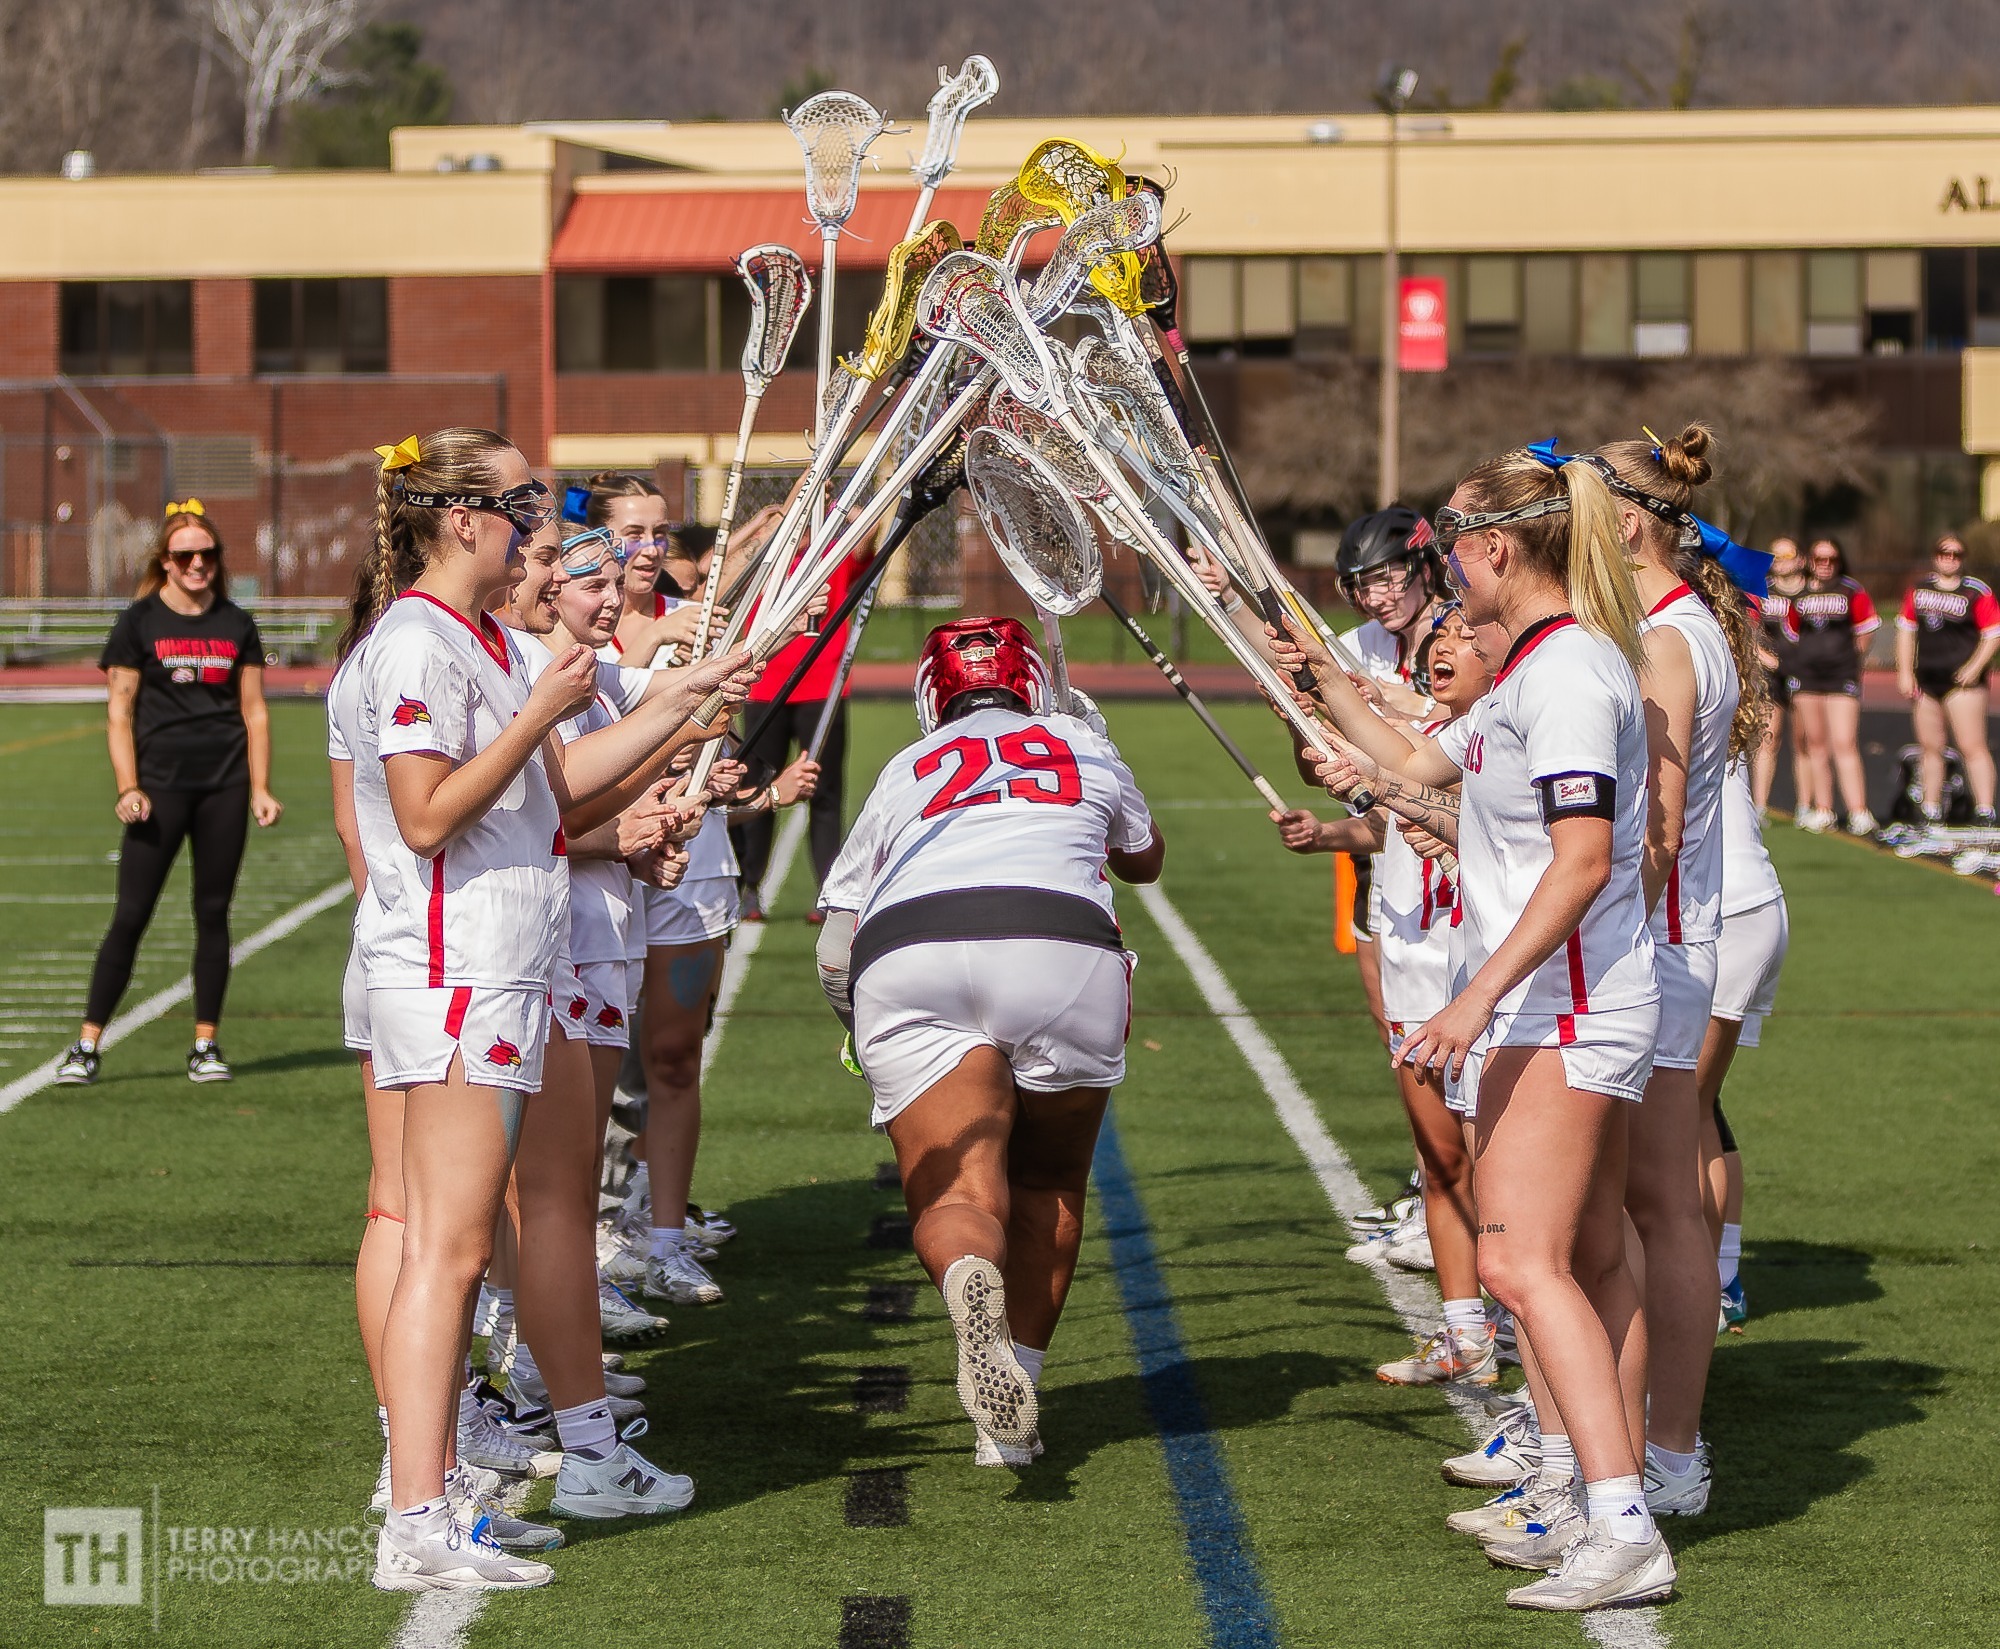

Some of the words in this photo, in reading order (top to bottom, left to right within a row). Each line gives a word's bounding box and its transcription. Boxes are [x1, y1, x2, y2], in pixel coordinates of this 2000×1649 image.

[445, 495, 482, 507] STX
[913, 725, 1084, 820] 29
[1486, 1223, 1507, 1233] one
